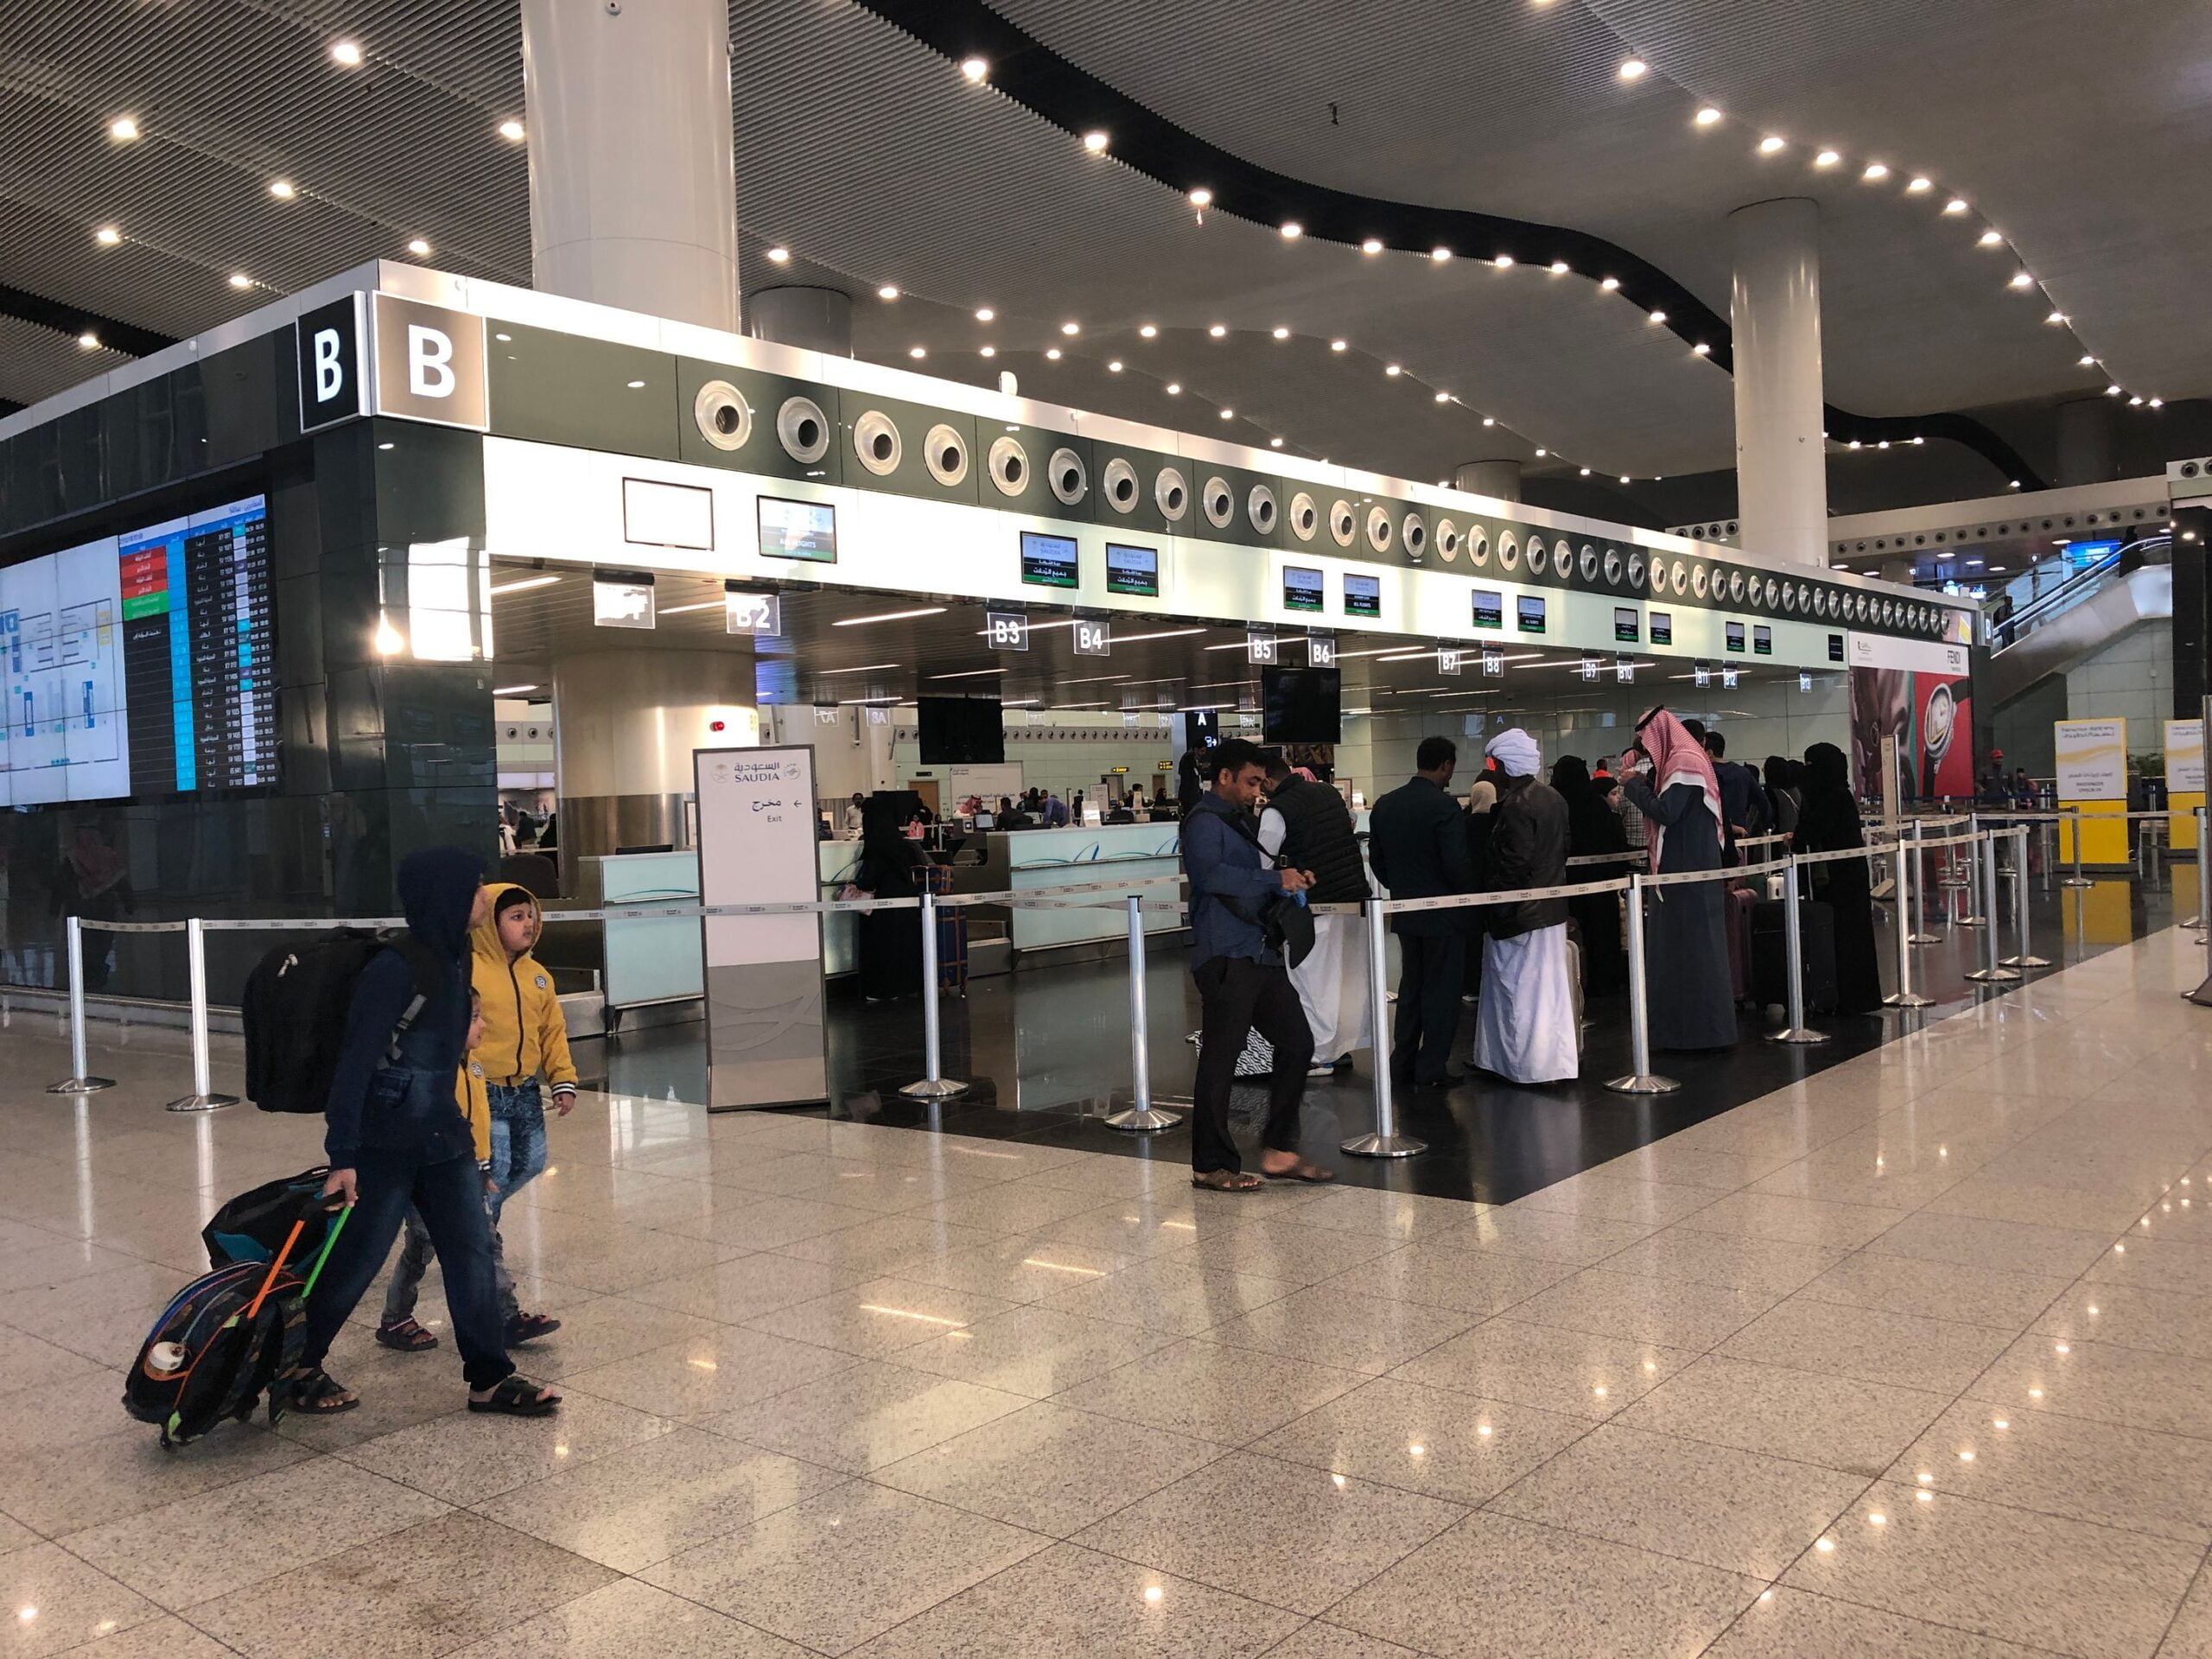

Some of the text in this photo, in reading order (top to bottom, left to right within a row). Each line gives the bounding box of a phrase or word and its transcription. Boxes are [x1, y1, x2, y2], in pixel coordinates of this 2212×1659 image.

[315, 328, 342, 403] B
[409, 324, 455, 397] B
[735, 600, 771, 629] B2
[995, 620, 1020, 644] B3
[1986, 618, 1992, 639] B
[1080, 627, 1103, 650] B4
[1254, 639, 1271, 659] B5
[1313, 644, 1330, 664] B6
[1443, 654, 1455, 671] B7
[1487, 657, 1500, 673] B8
[1586, 663, 1597, 677] B9
[1618, 666, 1632, 680] B10
[1697, 671, 1709, 684] B11
[1725, 672, 1736, 687] B12
[1198, 712, 1207, 726] A
[734, 762, 780, 772] السعودية
[734, 772, 780, 783] SAUDIA
[752, 799, 781, 812] مخرج
